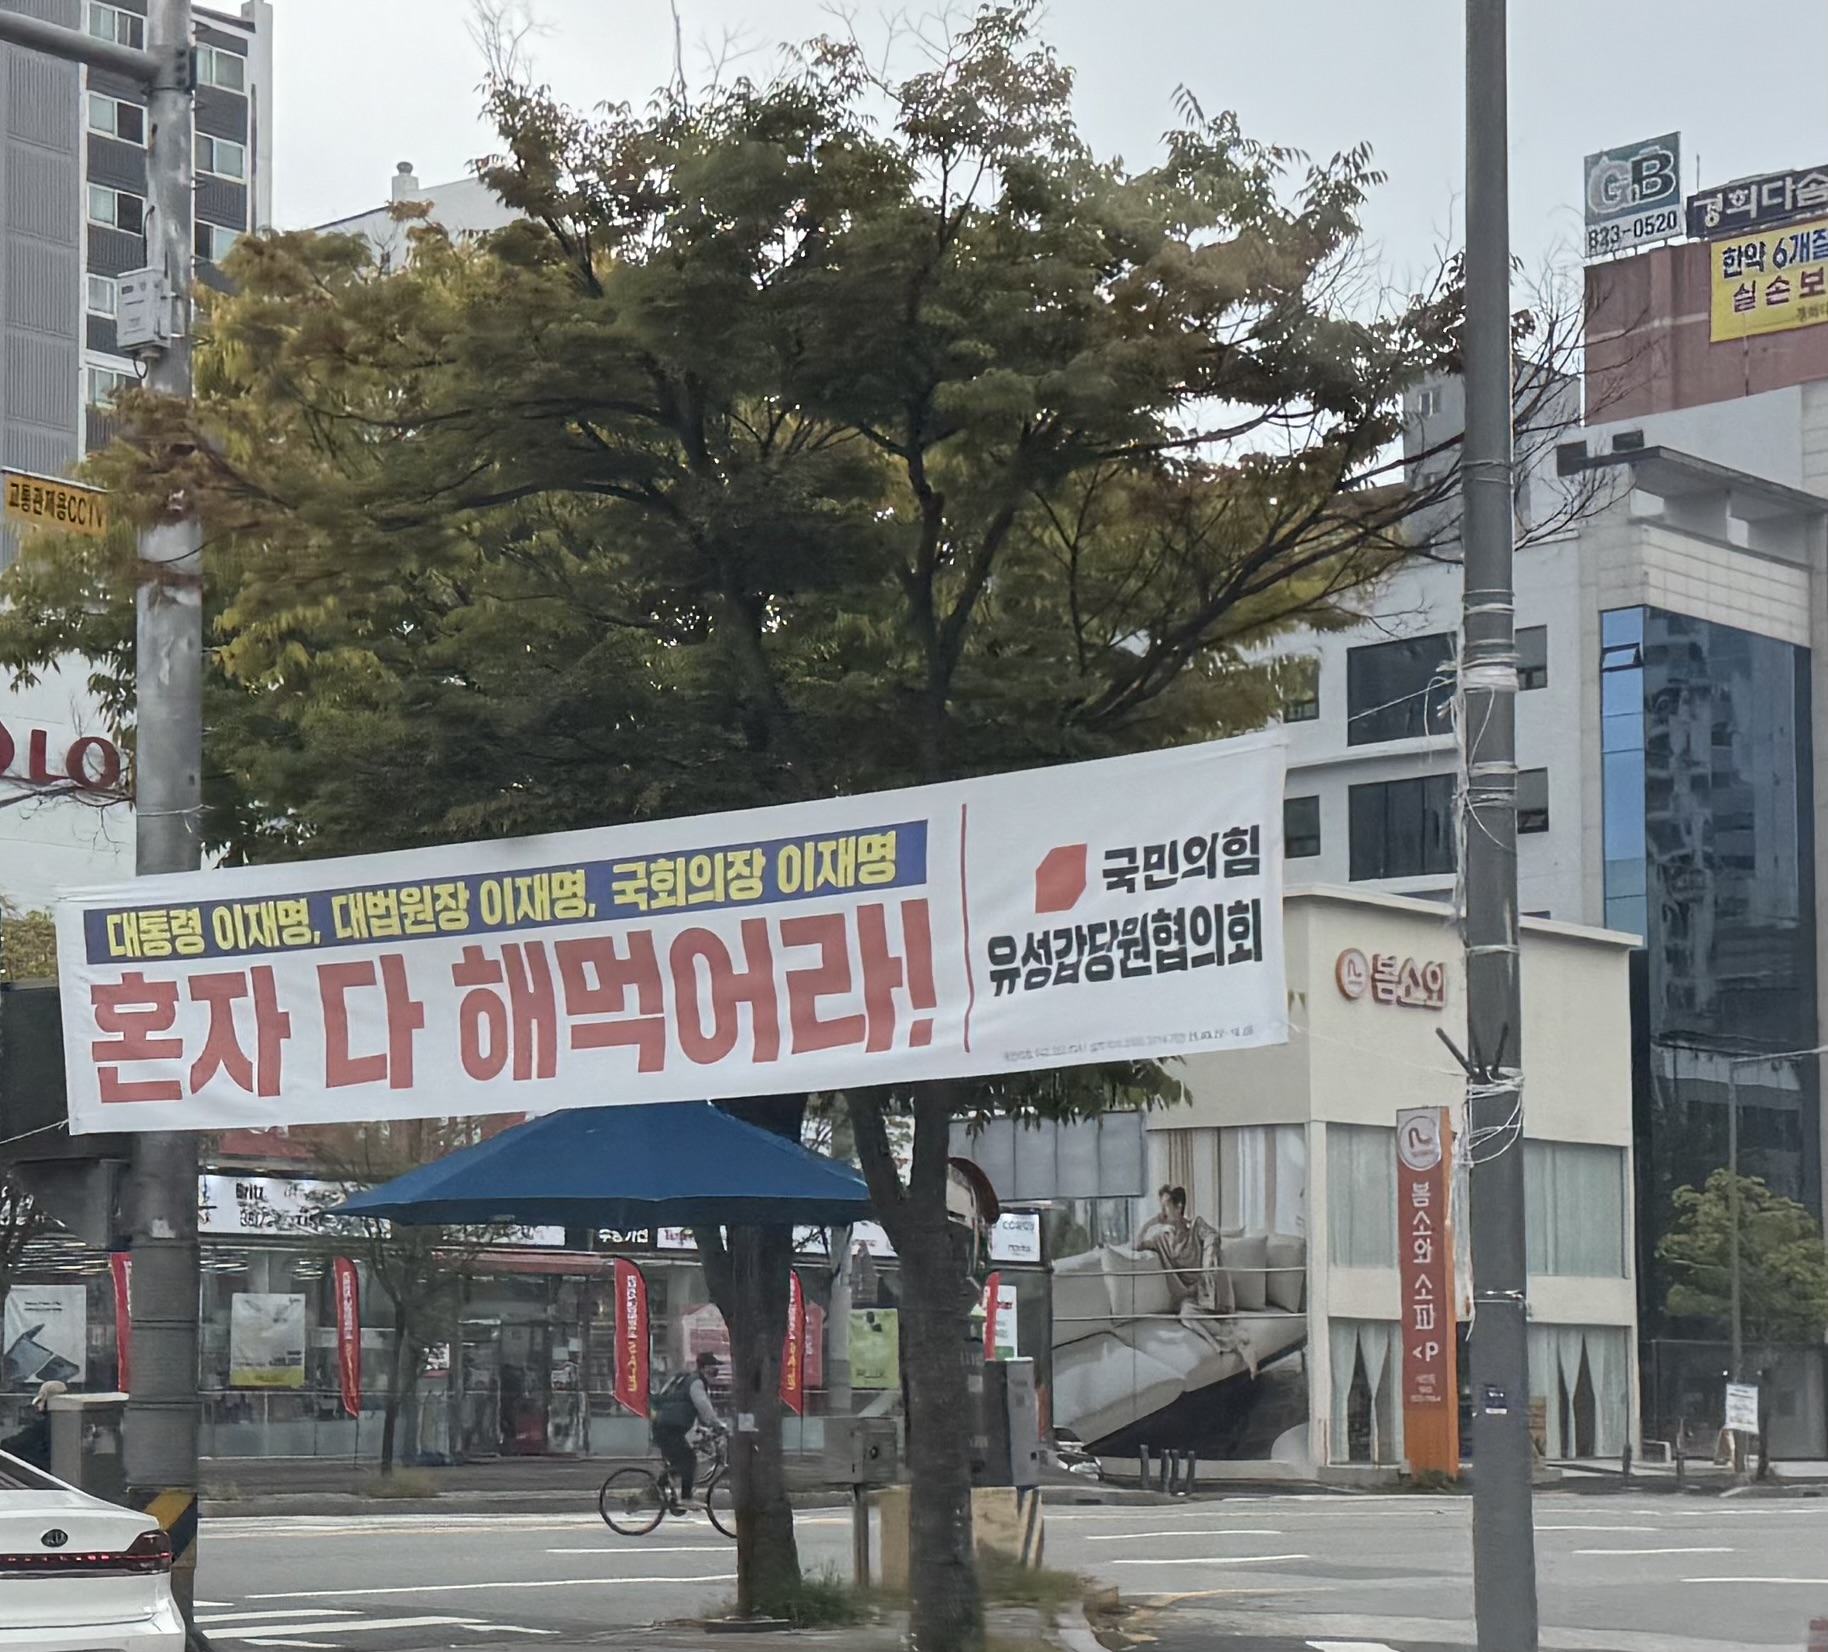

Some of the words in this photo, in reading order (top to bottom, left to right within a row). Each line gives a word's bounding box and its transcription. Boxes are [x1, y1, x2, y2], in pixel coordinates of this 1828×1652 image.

[1722, 241, 1766, 279] 한약
[106, 909, 205, 958] 대통령
[212, 898, 322, 950] 이재명,
[332, 882, 470, 939] 대법원장
[480, 868, 596, 926] 이재명,
[612, 846, 766, 910] 국회의장
[777, 830, 898, 893] 이재명
[1102, 824, 1262, 894] 국민의힘
[988, 899, 1264, 998] 유성갑당원협의회
[90, 965, 291, 1103] 혼자
[317, 953, 425, 1090] 다
[451, 899, 938, 1082] 해먹어라!
[1411, 1181, 1434, 1265] 봄소와
[1413, 1273, 1436, 1331] 소파
